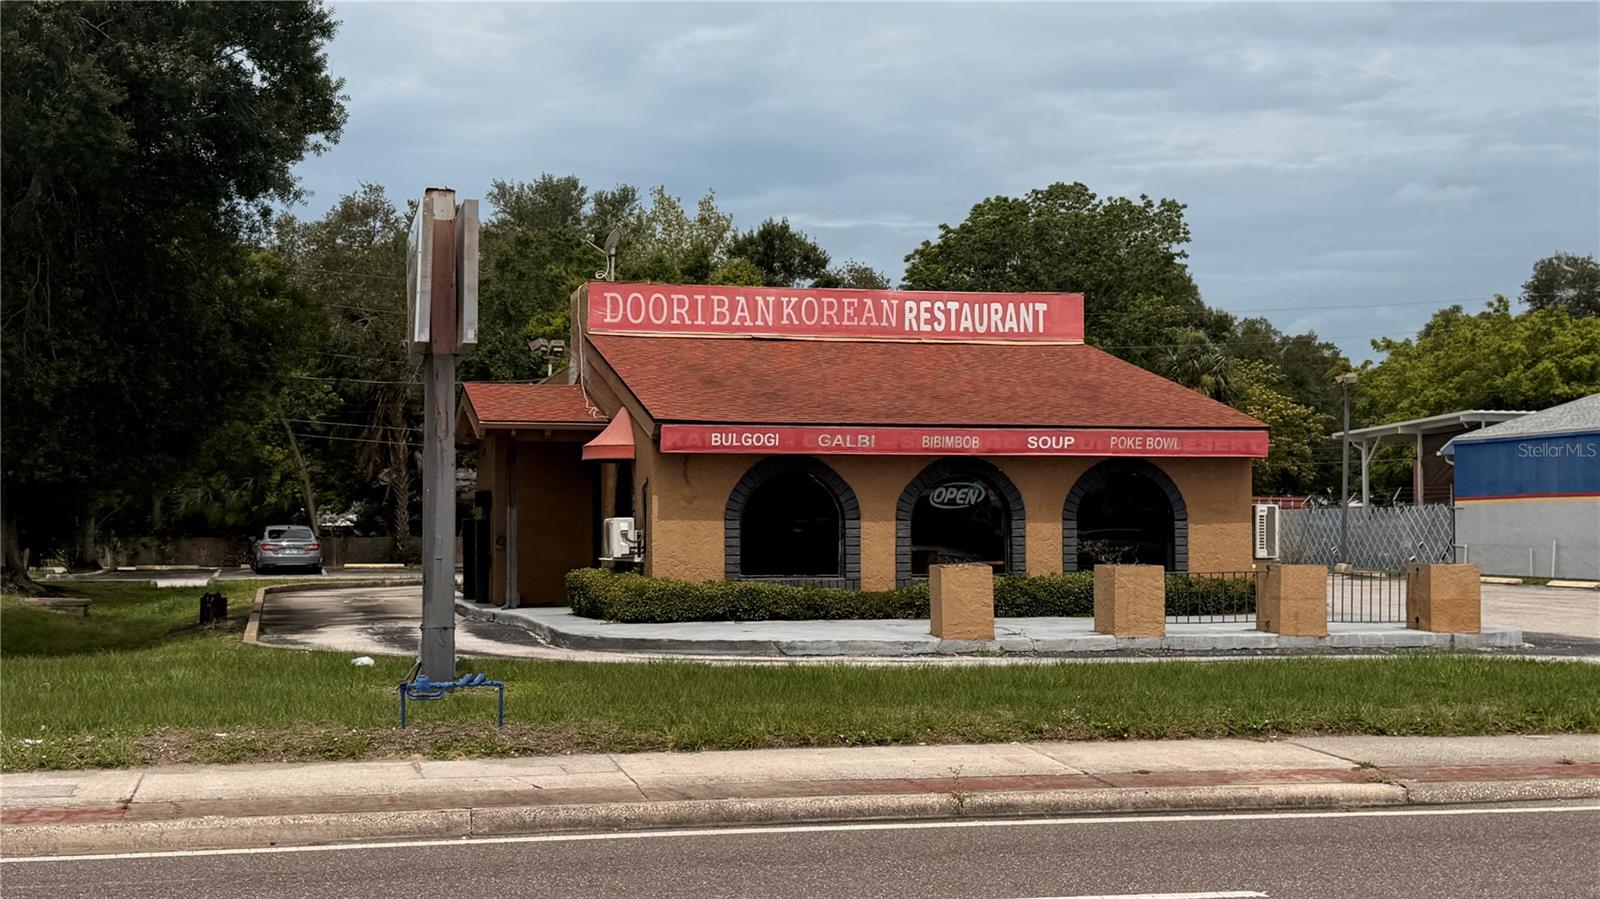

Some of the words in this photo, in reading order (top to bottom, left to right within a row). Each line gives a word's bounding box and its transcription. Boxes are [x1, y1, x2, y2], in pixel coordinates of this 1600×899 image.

[603, 292, 776, 327] DOORIBAN
[780, 296, 899, 328] KOREAN
[904, 300, 1048, 334] RESTAURANT
[711, 432, 779, 447] BULGOGI
[817, 433, 876, 449] GALBI
[921, 435, 980, 449] BIBIMBOB
[1027, 435, 1076, 449] SOUP
[1110, 436, 1143, 450] POKE
[1146, 437, 1181, 450] BOWL
[933, 486, 980, 505] OPEN
